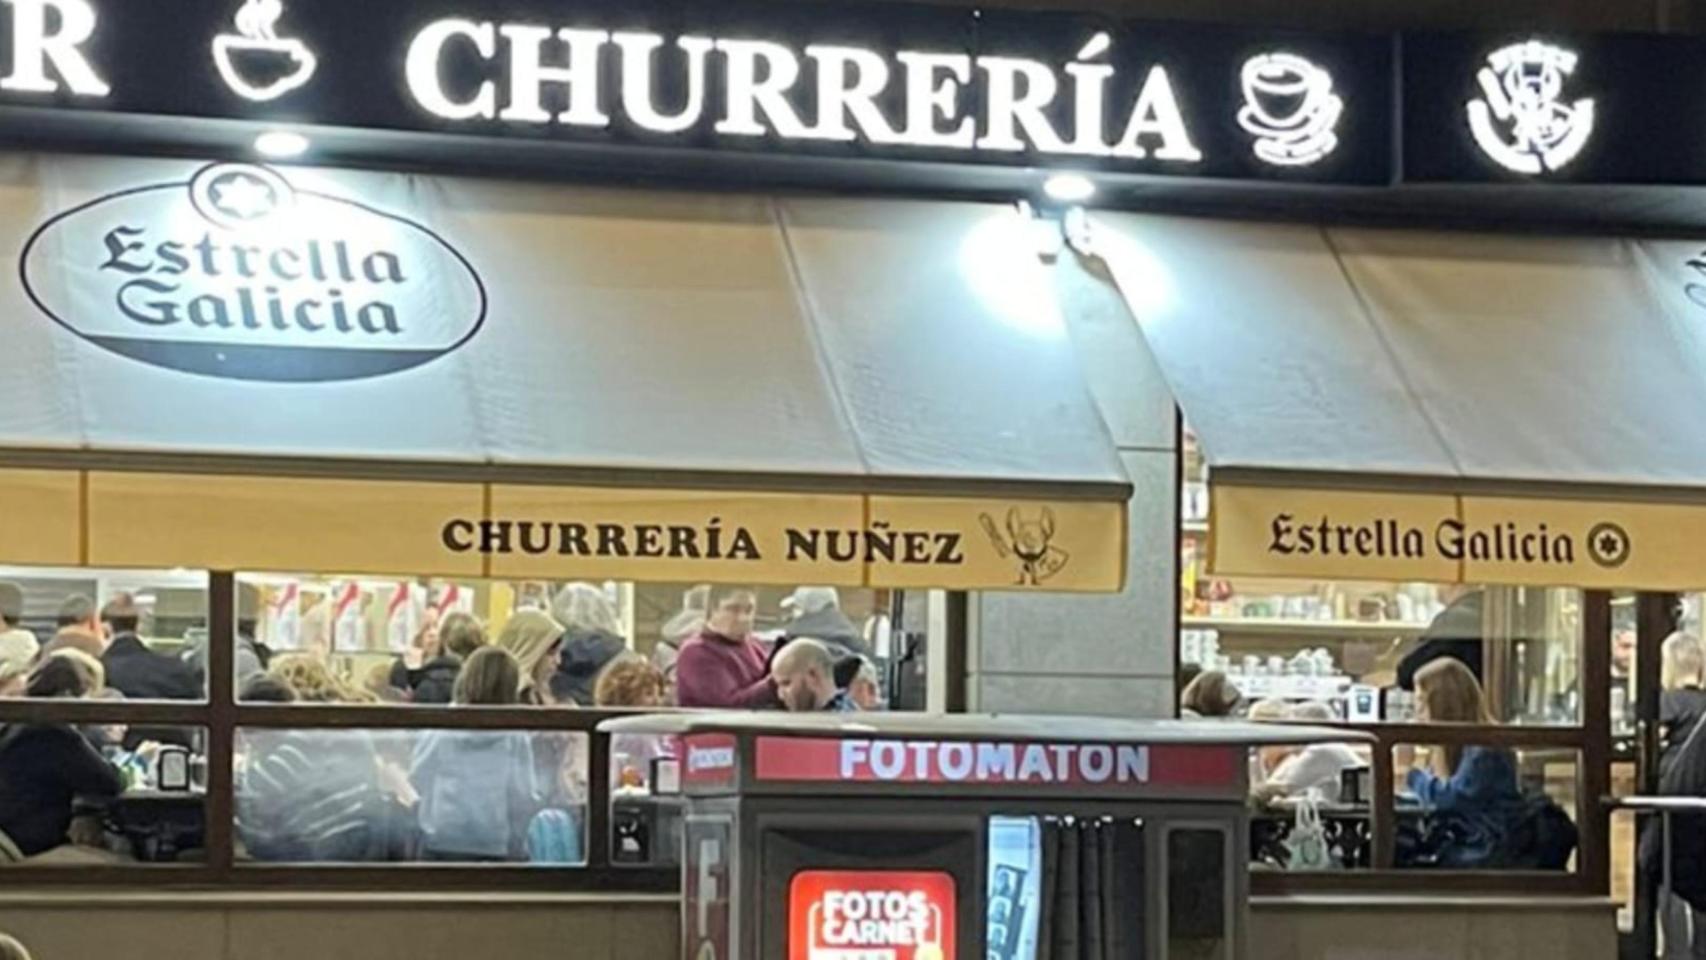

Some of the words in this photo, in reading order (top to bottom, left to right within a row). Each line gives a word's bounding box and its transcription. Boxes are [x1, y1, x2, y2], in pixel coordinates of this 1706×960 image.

[405, 18, 1201, 161] CHURRERÍA
[100, 225, 406, 284] Estrella
[116, 278, 403, 335] Galicia
[442, 517, 762, 561] CHURRERÍA
[786, 522, 963, 565] NUÑEZ
[1268, 514, 1425, 558] Estrella
[1435, 519, 1575, 564] Galicia
[840, 739, 1149, 782] FOTOMATON
[823, 890, 928, 920] FOTOS
